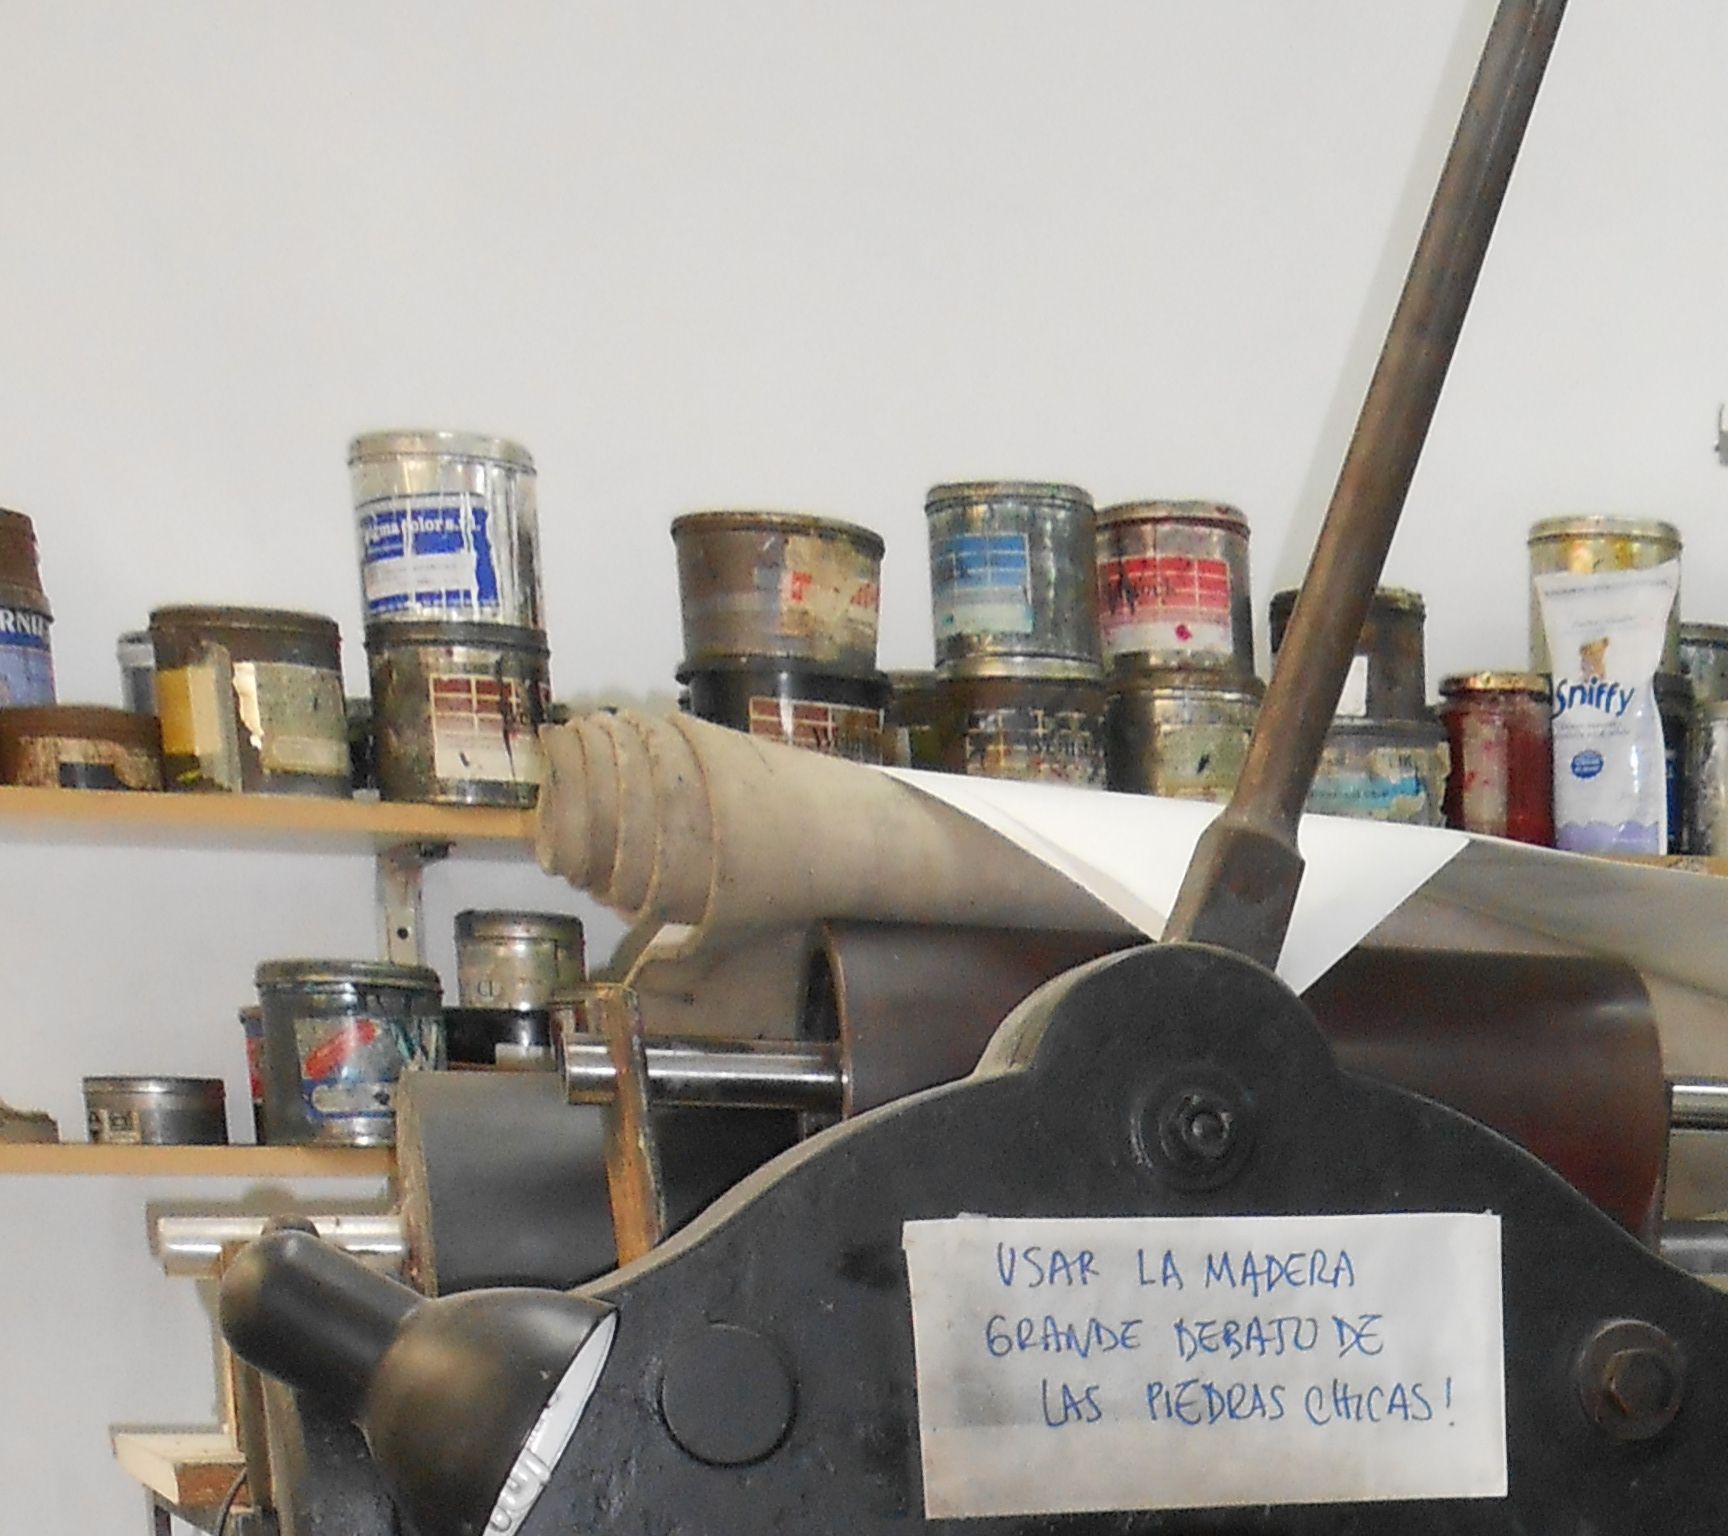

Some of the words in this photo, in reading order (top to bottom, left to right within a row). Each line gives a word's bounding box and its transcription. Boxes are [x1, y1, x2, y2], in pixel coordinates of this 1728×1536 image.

[1550, 675, 1636, 721] Sniffy
[997, 1241, 1100, 1289] USAR
[1137, 1248, 1185, 1291] LA
[1204, 1249, 1355, 1298] MADERA
[985, 1314, 1143, 1358] GRANDE
[1331, 1314, 1384, 1359] DE
[1041, 1378, 1102, 1428] LAS
[1147, 1378, 1287, 1426] PIEDRAS
